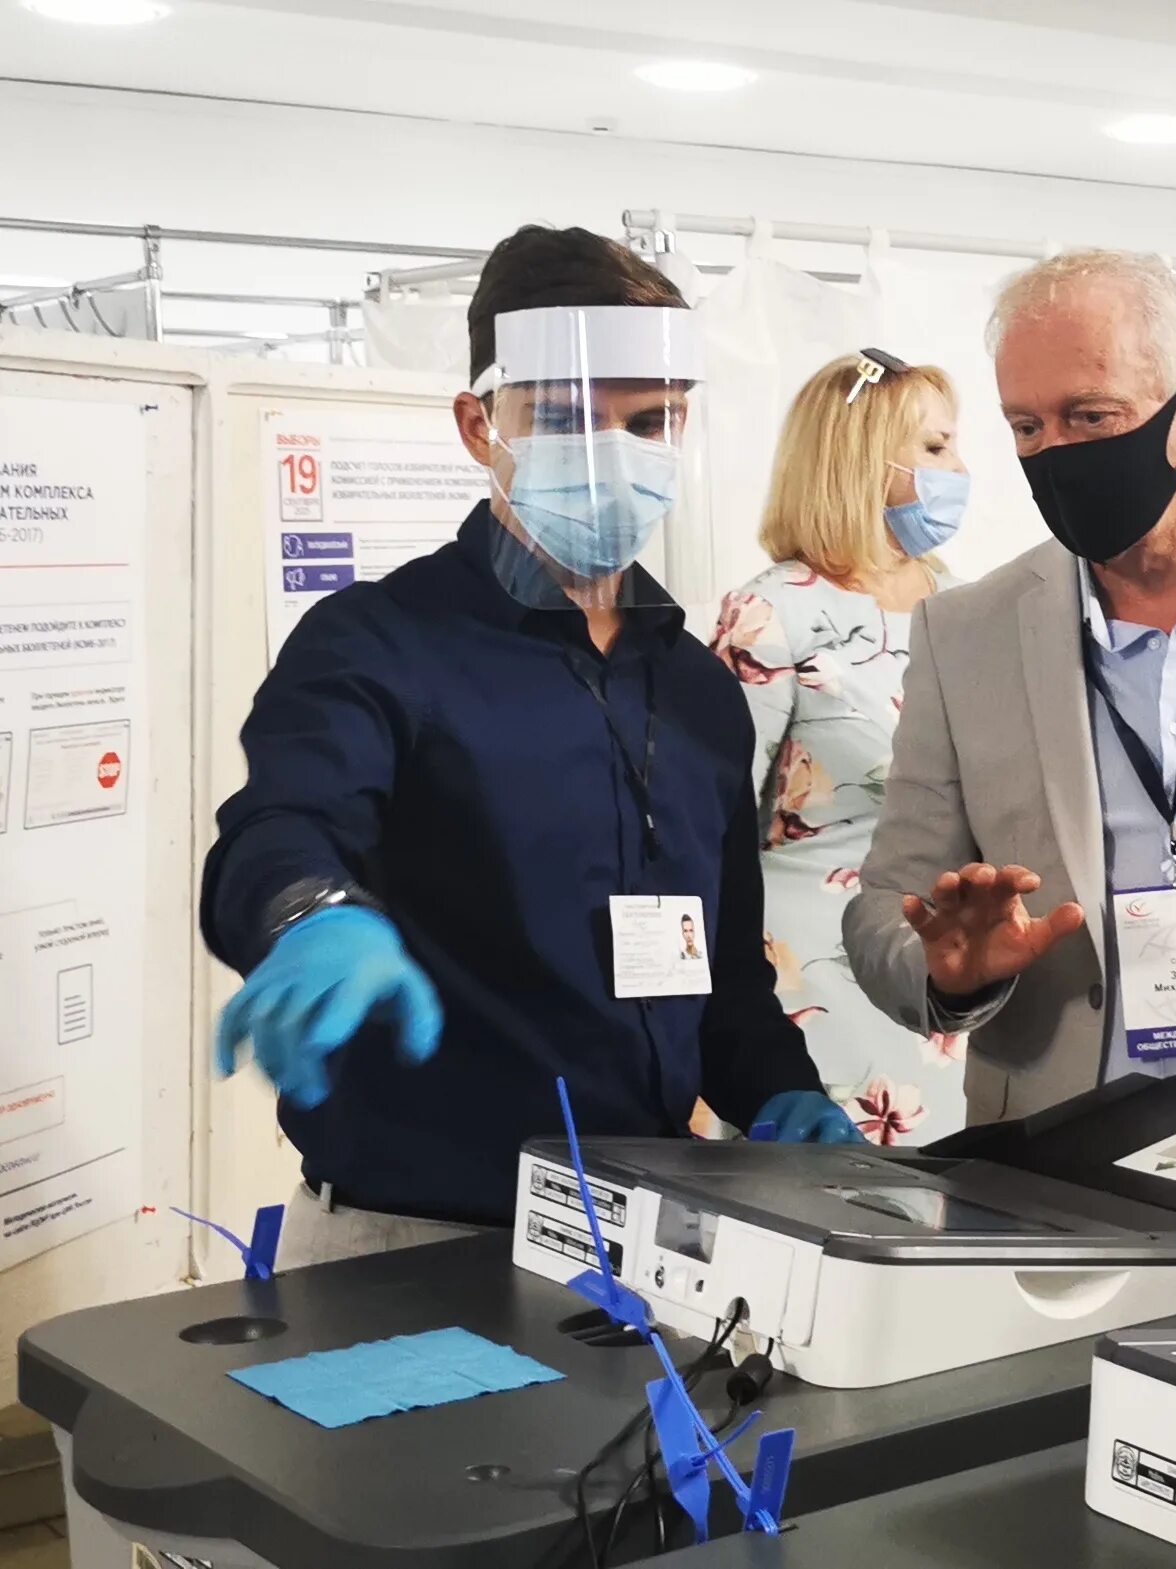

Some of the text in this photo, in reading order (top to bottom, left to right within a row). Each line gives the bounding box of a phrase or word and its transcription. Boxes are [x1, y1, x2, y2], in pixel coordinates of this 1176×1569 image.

[0, 463, 37, 477] АНИЯ
[281, 454, 316, 494] 19
[15, 484, 94, 500] КОМПЛЕКСА
